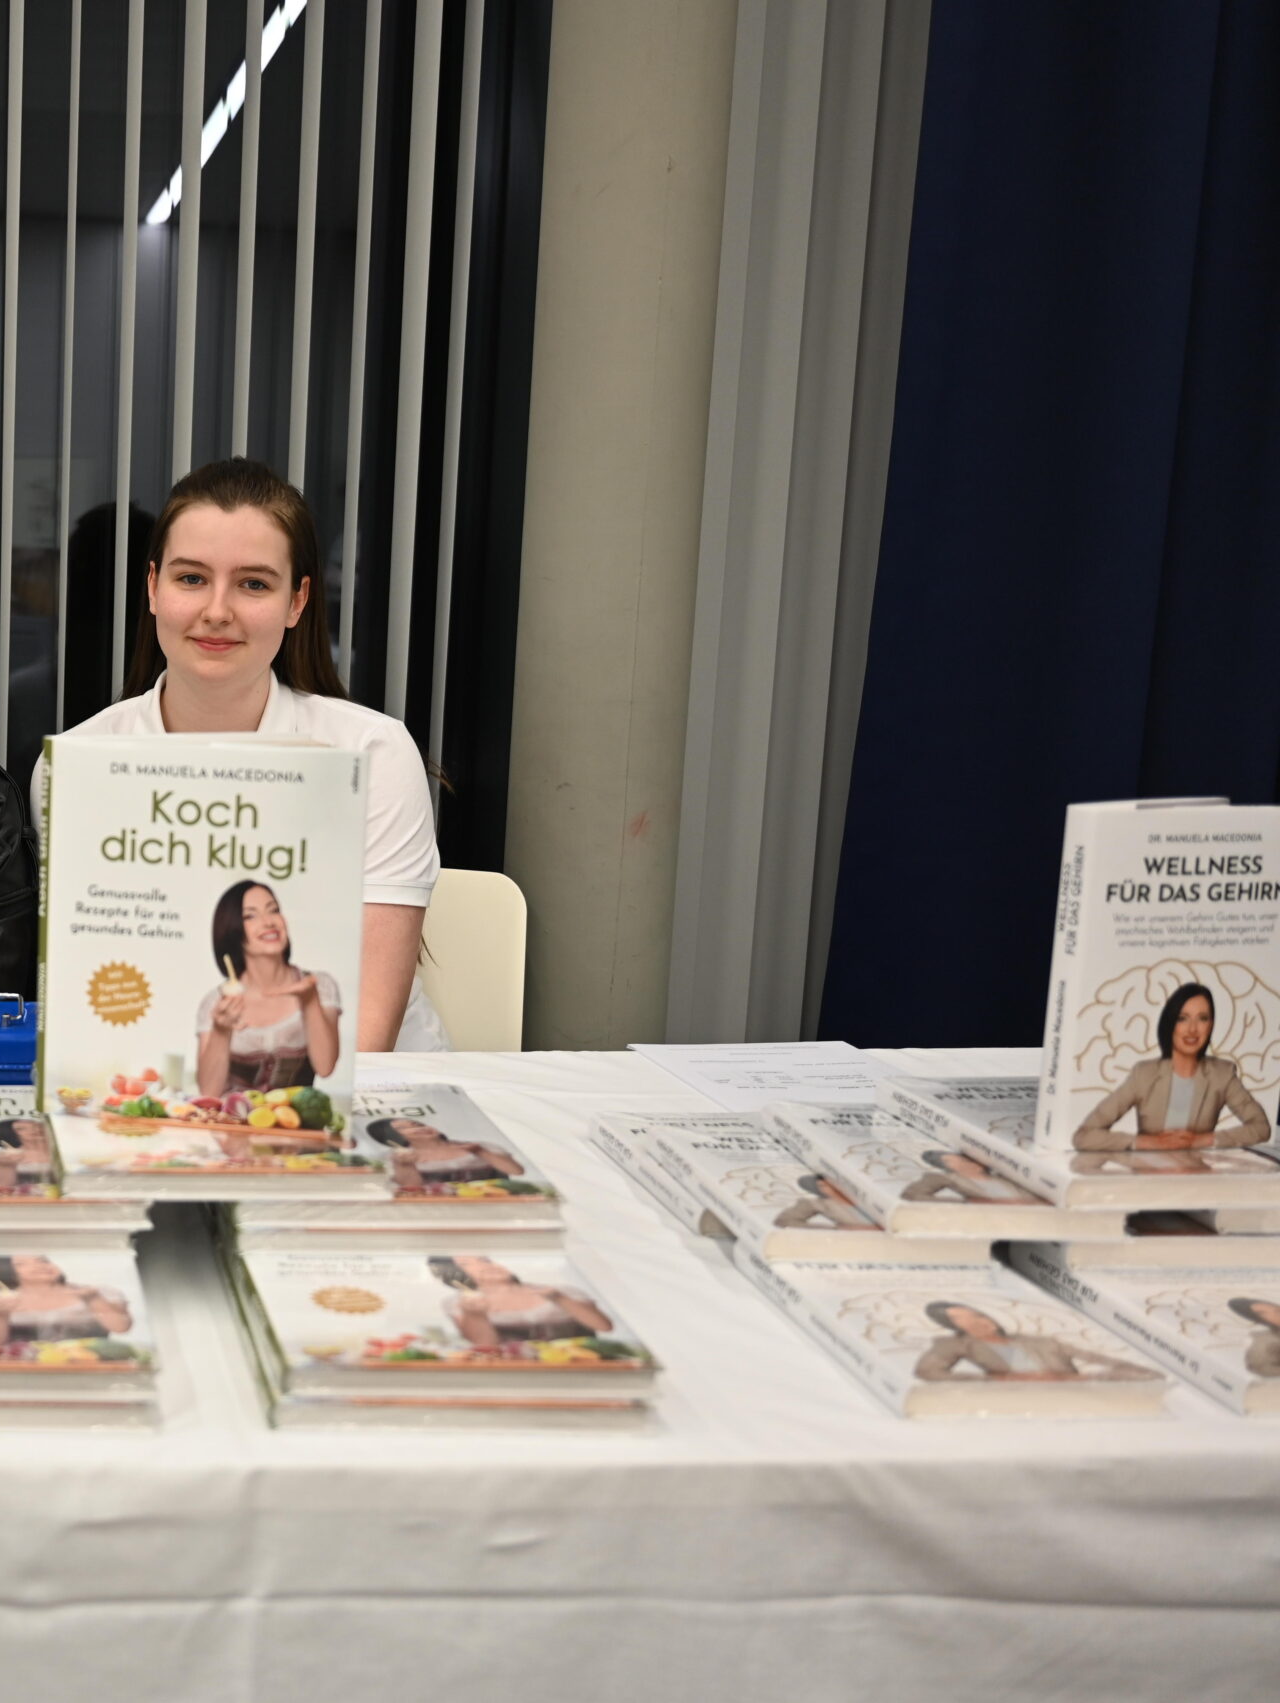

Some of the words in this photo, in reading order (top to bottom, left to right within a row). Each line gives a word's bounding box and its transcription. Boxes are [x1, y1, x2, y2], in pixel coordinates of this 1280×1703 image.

[110, 762, 130, 775] DR.
[136, 764, 207, 778] MANUELA
[213, 767, 304, 783] MACEDONIA
[151, 790, 258, 829] Koch
[1166, 834, 1209, 843] MANUELA
[1212, 833, 1263, 842] MACEDONIA
[101, 829, 191, 866] dich
[208, 834, 308, 880] klug!
[1144, 856, 1263, 875] WELLNESS
[1071, 845, 1085, 897] GEHIRN
[87, 883, 168, 902] Genussvolle
[1056, 863, 1071, 932] WELLNESS
[1106, 880, 1151, 903] FÜR
[1159, 883, 1201, 902] DAS
[75, 900, 130, 918] Rezepte
[134, 904, 154, 919] für
[159, 910, 180, 921] ein
[1068, 901, 1080, 926] DAS
[70, 921, 133, 936] gesundes
[137, 923, 184, 939] Gehirn
